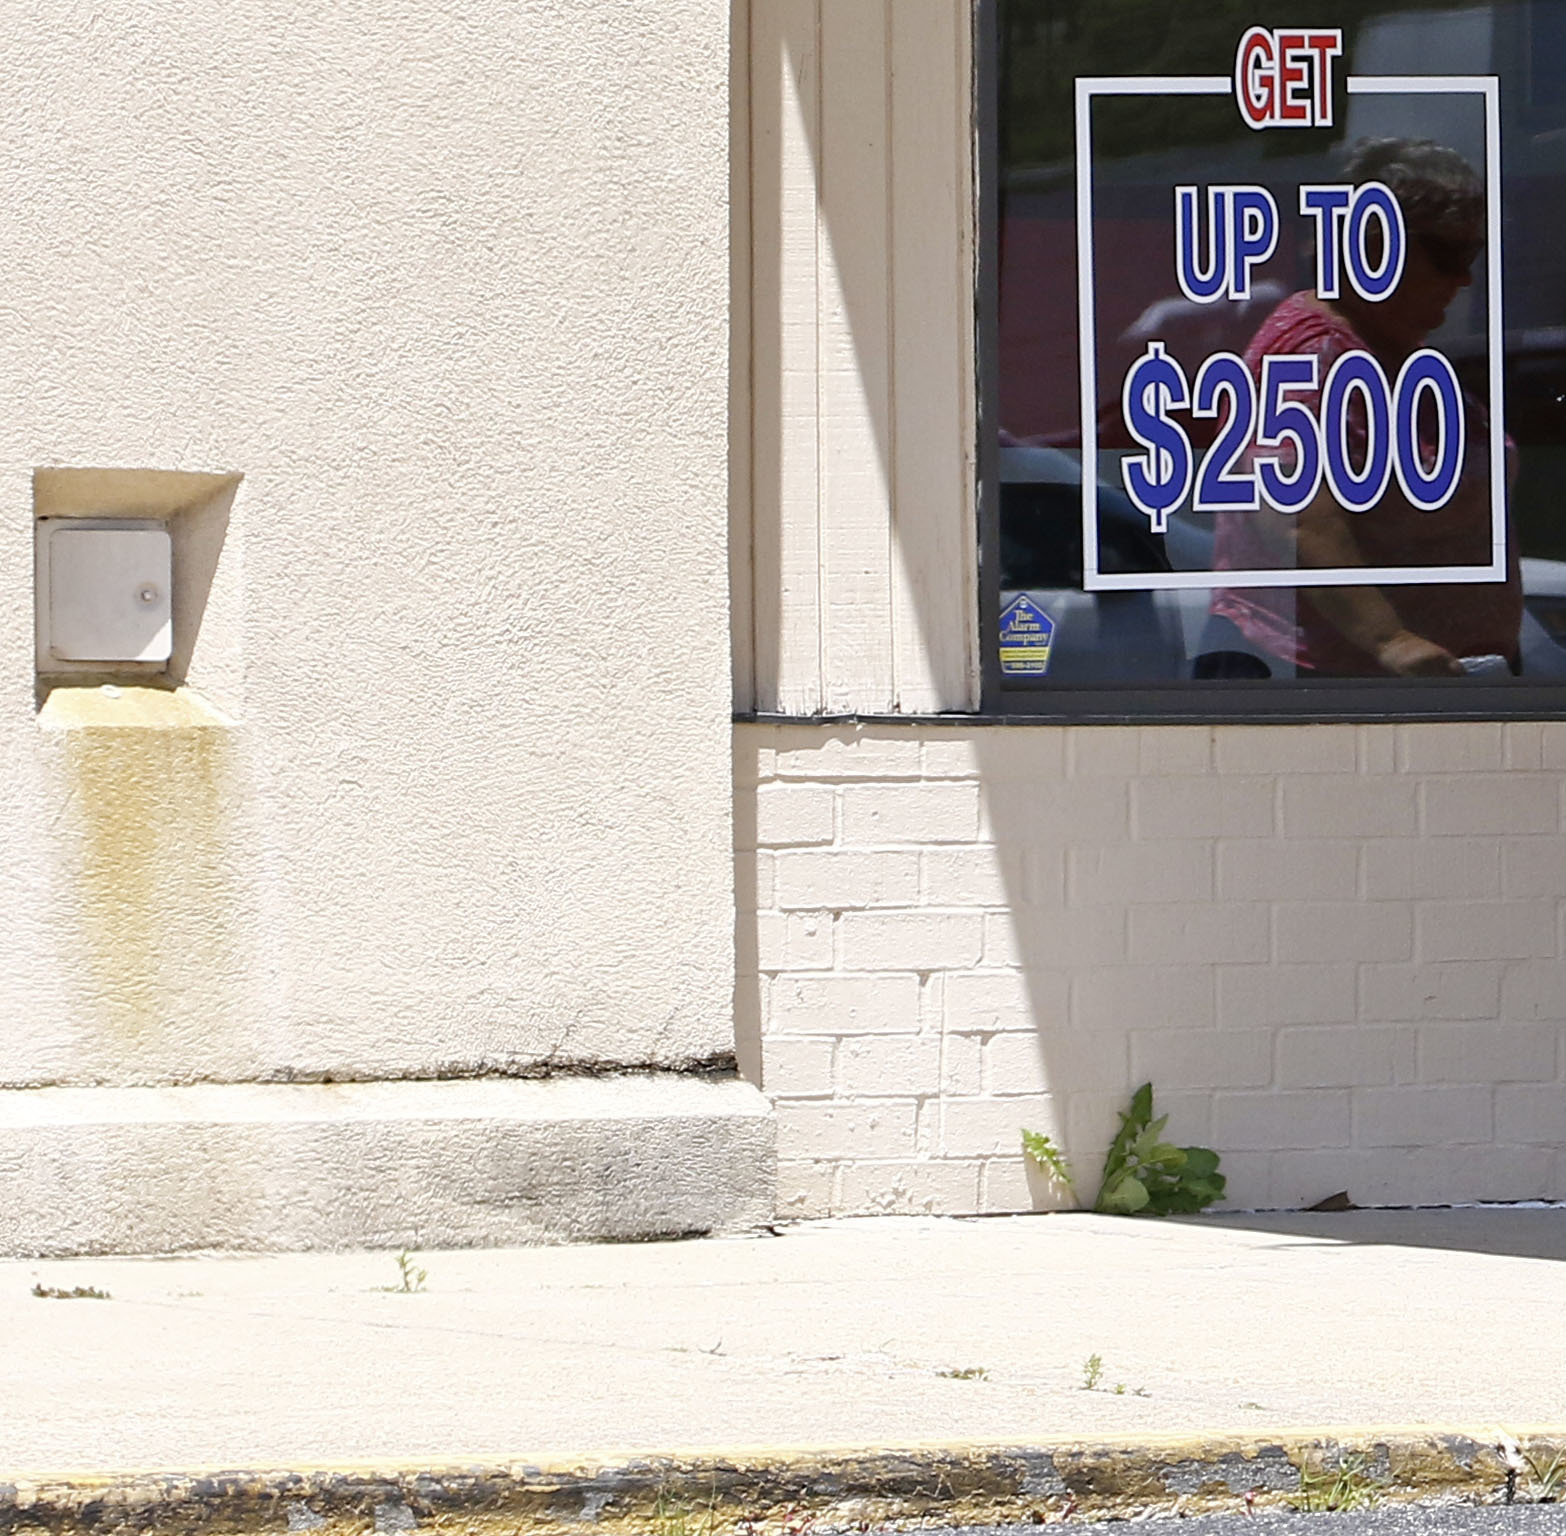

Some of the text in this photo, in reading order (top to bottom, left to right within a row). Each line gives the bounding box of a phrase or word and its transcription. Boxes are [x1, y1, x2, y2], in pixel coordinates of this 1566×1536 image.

[1235, 26, 1343, 130] GET
[1175, 181, 1406, 304] UP TO
[1121, 341, 1466, 534] $2500
